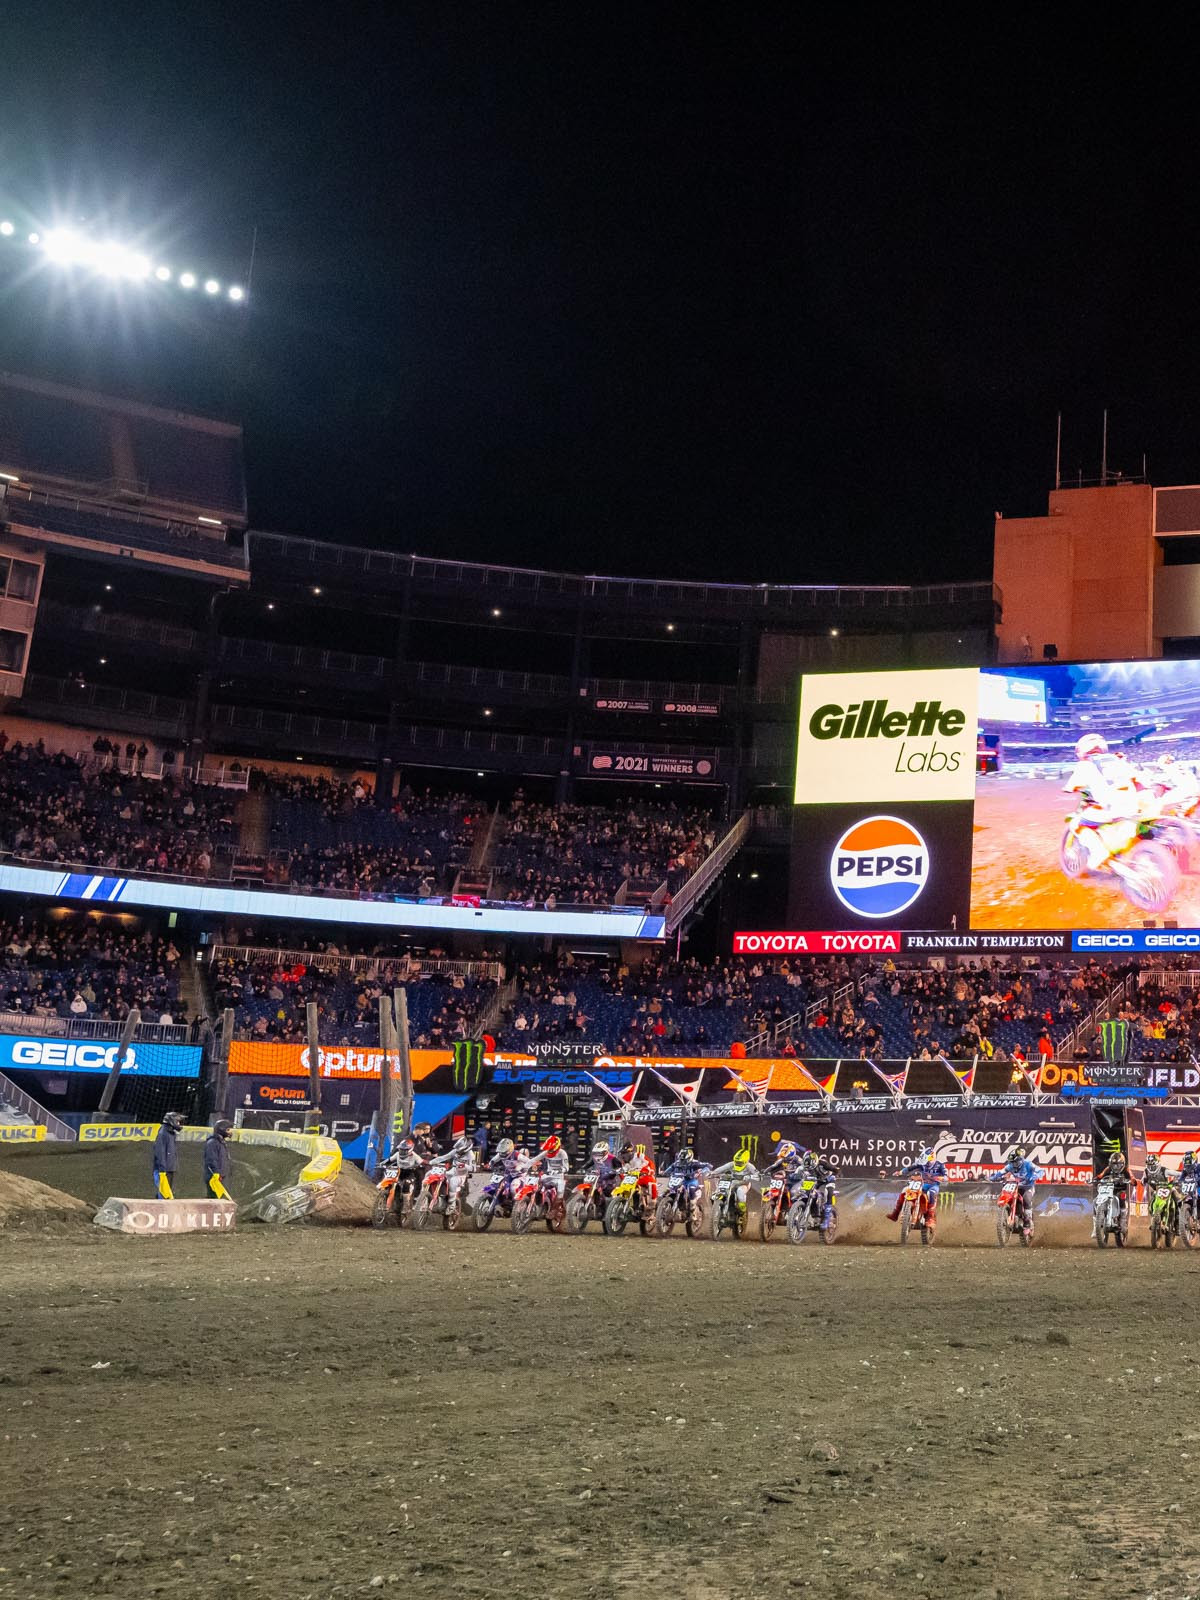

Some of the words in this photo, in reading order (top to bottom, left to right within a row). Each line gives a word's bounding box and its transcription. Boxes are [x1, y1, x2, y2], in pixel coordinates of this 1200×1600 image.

[607, 700, 628, 709] 2007
[809, 699, 966, 741] Gillette
[615, 756, 648, 771] 2021
[895, 741, 961, 773] Labs
[652, 764, 693, 774] WINNERS
[837, 855, 923, 877] PEPSI
[736, 935, 808, 950] TOYOTA
[821, 934, 896, 950] TOYOTA
[907, 936, 976, 948] FRANKLIN
[978, 935, 1064, 948] TEMPLETON
[1077, 934, 1133, 947] GEICO
[1145, 934, 1200, 946] GEICO
[527, 1041, 601, 1056] MONSTER
[493, 1070, 633, 1084] SUPERCROSS
[1084, 1065, 1142, 1077] MONSTER
[259, 1086, 306, 1100] Optum
[530, 1084, 593, 1095] Championship
[1089, 1097, 1138, 1106] Championship
[84, 1127, 153, 1139] SUZUKI
[960, 1128, 1016, 1144] ROCKY
[819, 1138, 860, 1150] UTAH
[867, 1139, 926, 1152] SPORTS
[770, 1180, 783, 1189] 39
[159, 1212, 235, 1228] OAKLEY
